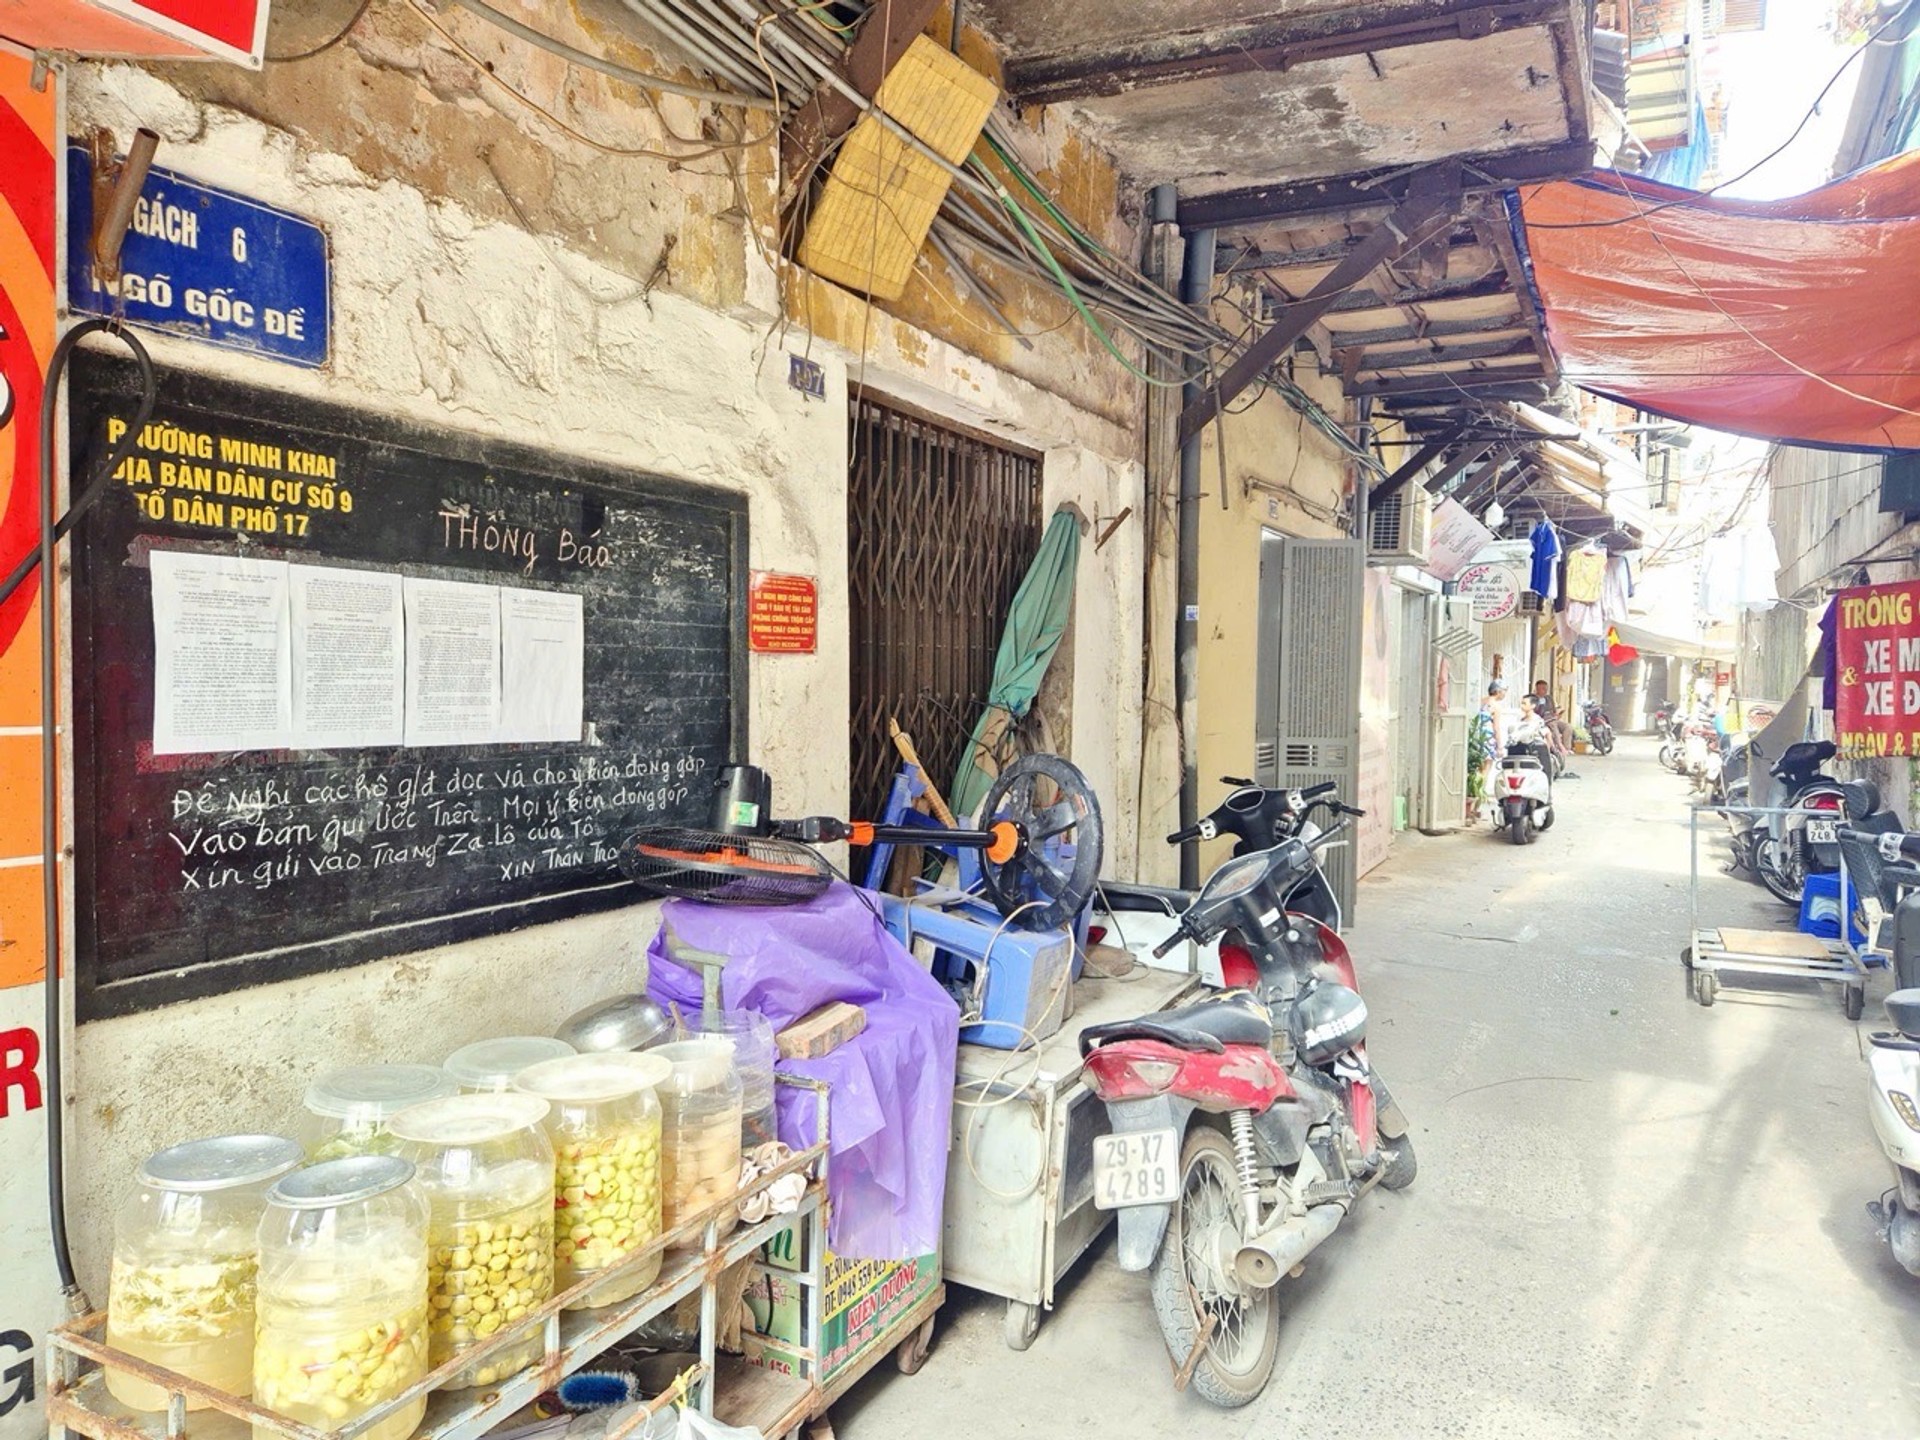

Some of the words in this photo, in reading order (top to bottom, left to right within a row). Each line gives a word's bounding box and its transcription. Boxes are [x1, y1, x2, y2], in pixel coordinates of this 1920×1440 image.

[127, 192, 197, 249] GÁCH
[232, 227, 247, 262] 6
[185, 287, 254, 328] GỐC
[264, 307, 305, 341] ĐỀ
[108, 416, 213, 460] PƯỜNG
[220, 437, 281, 470] MINH
[288, 450, 336, 480] KHAI
[160, 458, 213, 493] BÀN
[216, 468, 265, 500] DÂN
[271, 480, 303, 505] CƯ
[307, 481, 338, 510] SỐ
[340, 491, 353, 513] 9
[133, 487, 166, 520] TỔ
[173, 495, 223, 527] DÂN
[230, 505, 280, 534] PHỐ
[283, 513, 309, 536] 17
[1842, 590, 1912, 630] TRÔNG
[1864, 638, 1891, 674] XE
[1842, 666, 1857, 687] &
[1864, 681, 1895, 716] XE
[447, 767, 484, 796] đọc
[503, 795, 540, 823] Mọi
[1106, 1167, 1165, 1202] 4289
